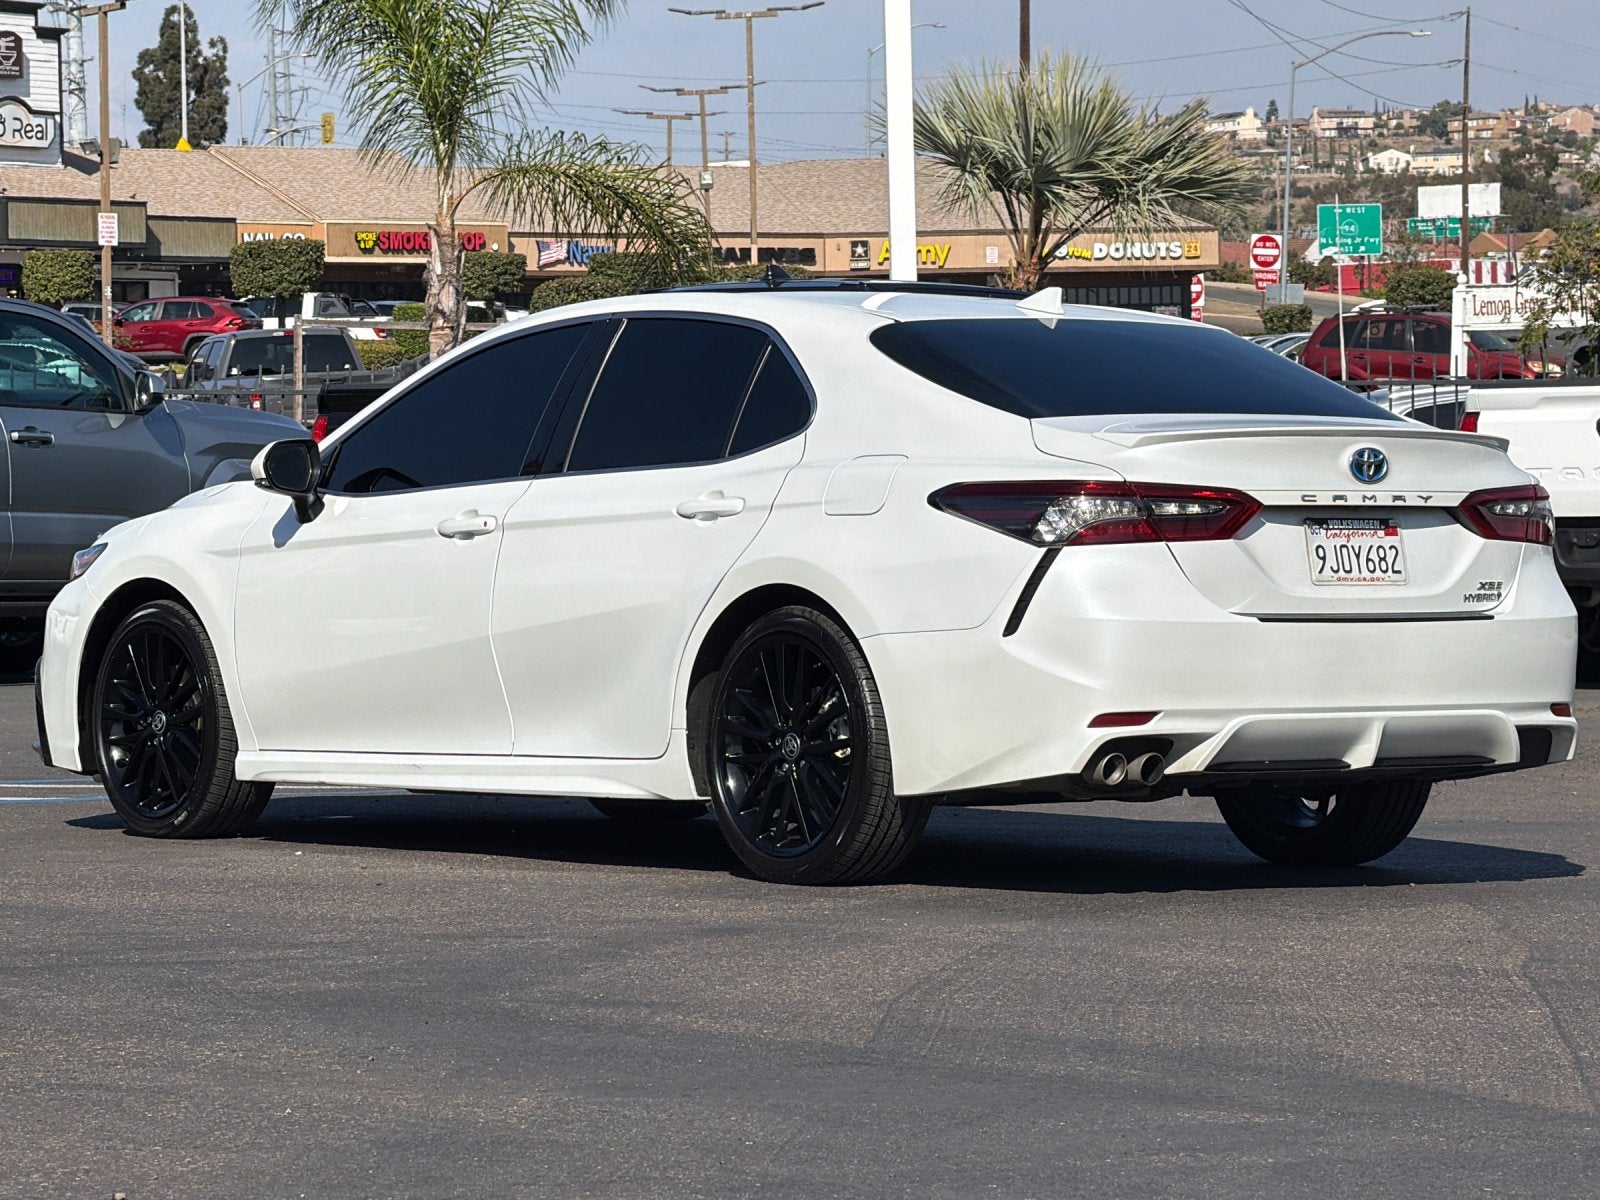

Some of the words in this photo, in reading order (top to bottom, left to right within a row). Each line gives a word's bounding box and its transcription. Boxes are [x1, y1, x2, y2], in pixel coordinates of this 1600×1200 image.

[12, 117, 48, 141] Real
[356, 232, 377, 241] SMOKE
[359, 241, 365, 249] &
[1093, 241, 1183, 259] DONUTS
[1186, 245, 1199, 253] 24
[877, 240, 950, 267] Amy
[1472, 294, 1511, 316] Lemon
[1301, 494, 1433, 504] CAMRY
[1327, 519, 1380, 529] VOLKSWAGEN
[1325, 529, 1386, 543] California
[1476, 581, 1503, 591] XSE
[1463, 592, 1498, 603] HYBRID
